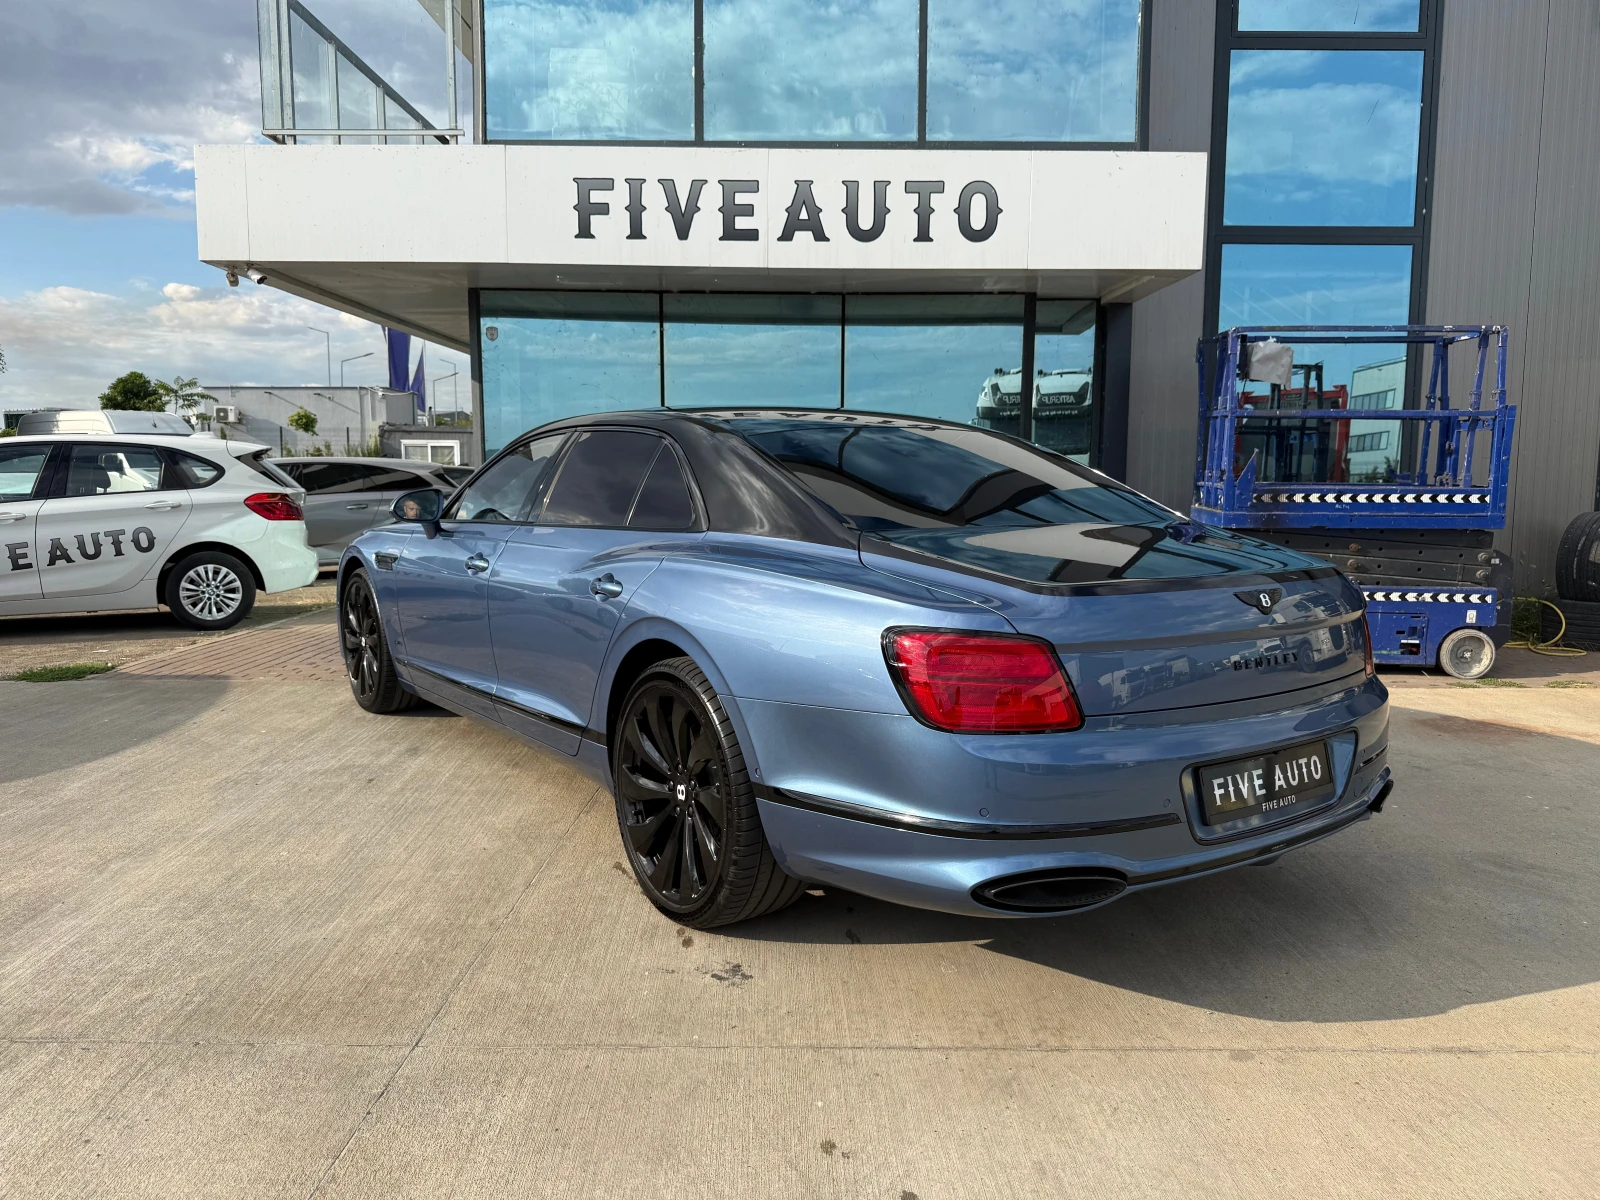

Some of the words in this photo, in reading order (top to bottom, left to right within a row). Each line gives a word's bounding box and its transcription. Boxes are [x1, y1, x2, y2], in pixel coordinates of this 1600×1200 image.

[47, 526, 156, 567] AUTO
[1234, 652, 1299, 672] BENTLEY
[1212, 768, 1267, 806] FIVE
[1274, 755, 1322, 791] AUTO
[1262, 799, 1278, 812] FIVE
[1280, 795, 1296, 808] AUTO
